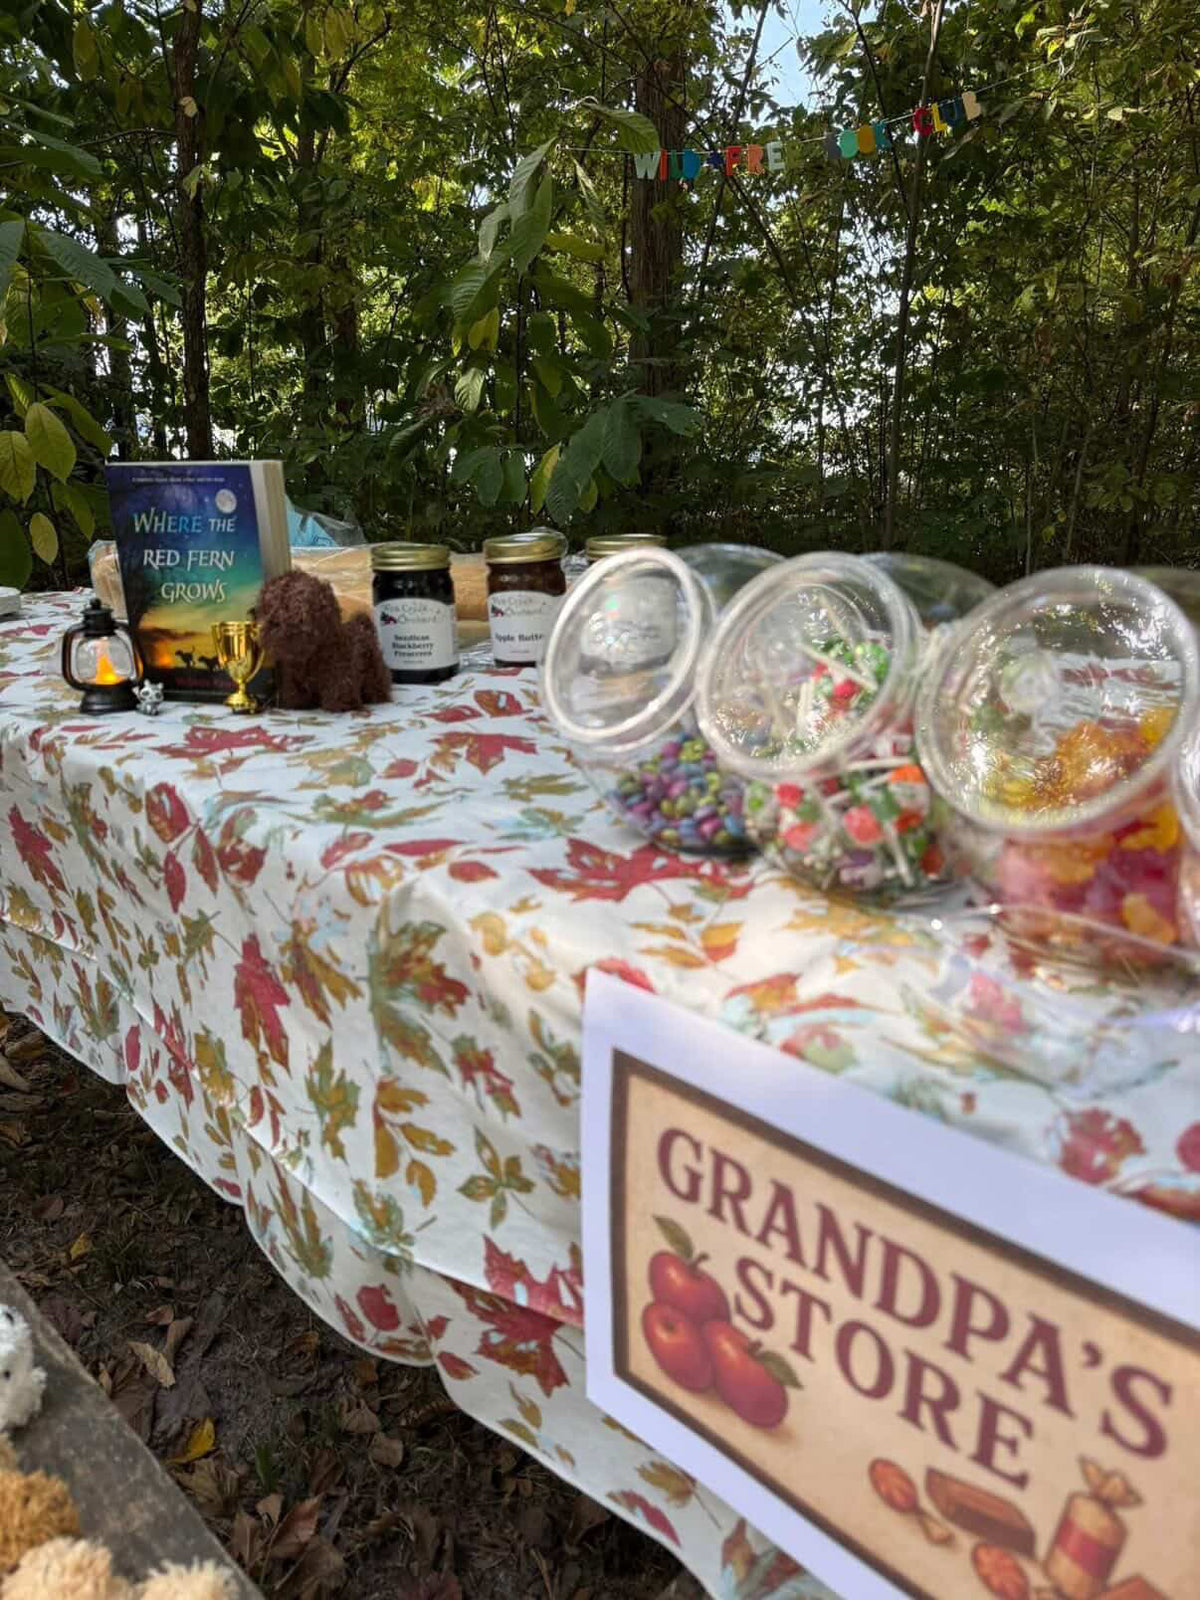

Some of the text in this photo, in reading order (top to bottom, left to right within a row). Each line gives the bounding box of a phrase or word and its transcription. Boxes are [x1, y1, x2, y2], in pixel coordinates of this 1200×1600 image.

[913, 90, 983, 138] CLUB
[633, 147, 701, 181] WILD
[134, 507, 236, 534] WHERE THE
[143, 548, 235, 571] RED FERN
[161, 579, 227, 603] GROWS
[391, 640, 434, 650] Blackberry
[656, 1126, 1175, 1461] GRANDPA'S
[733, 1256, 1036, 1491] STORE
